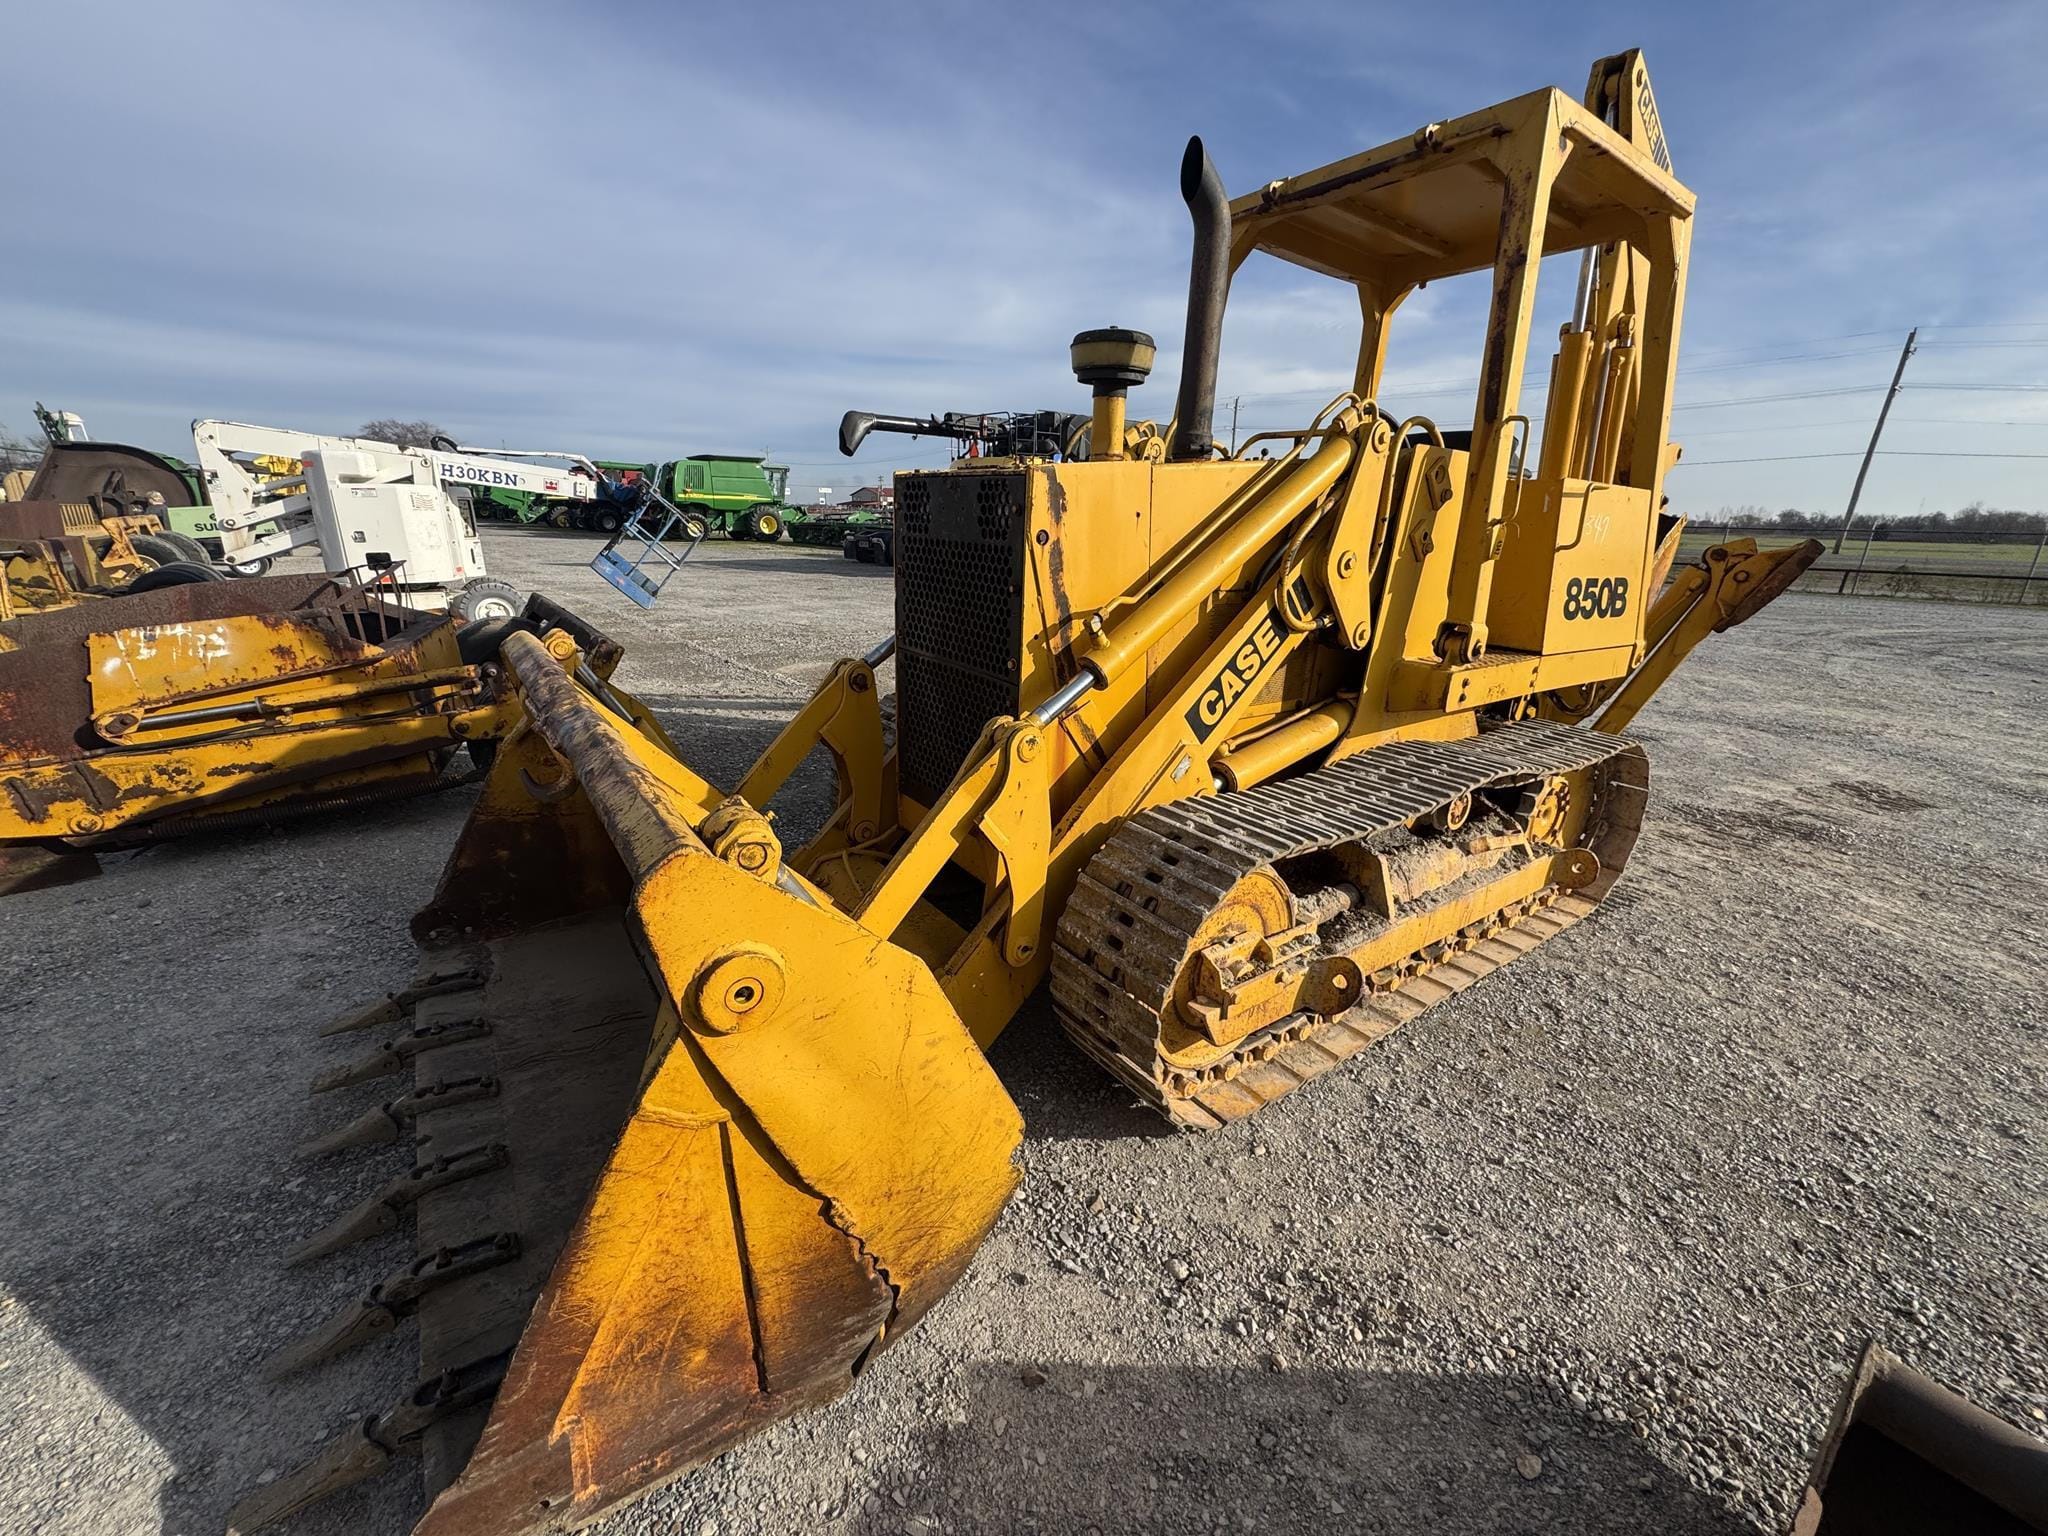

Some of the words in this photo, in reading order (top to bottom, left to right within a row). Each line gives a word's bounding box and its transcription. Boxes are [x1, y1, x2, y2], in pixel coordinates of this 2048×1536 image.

[1641, 89, 1660, 149] CASE
[441, 463, 519, 487] H30KBN
[1563, 577, 1629, 620] 850B
[1199, 618, 1281, 726] CASE
